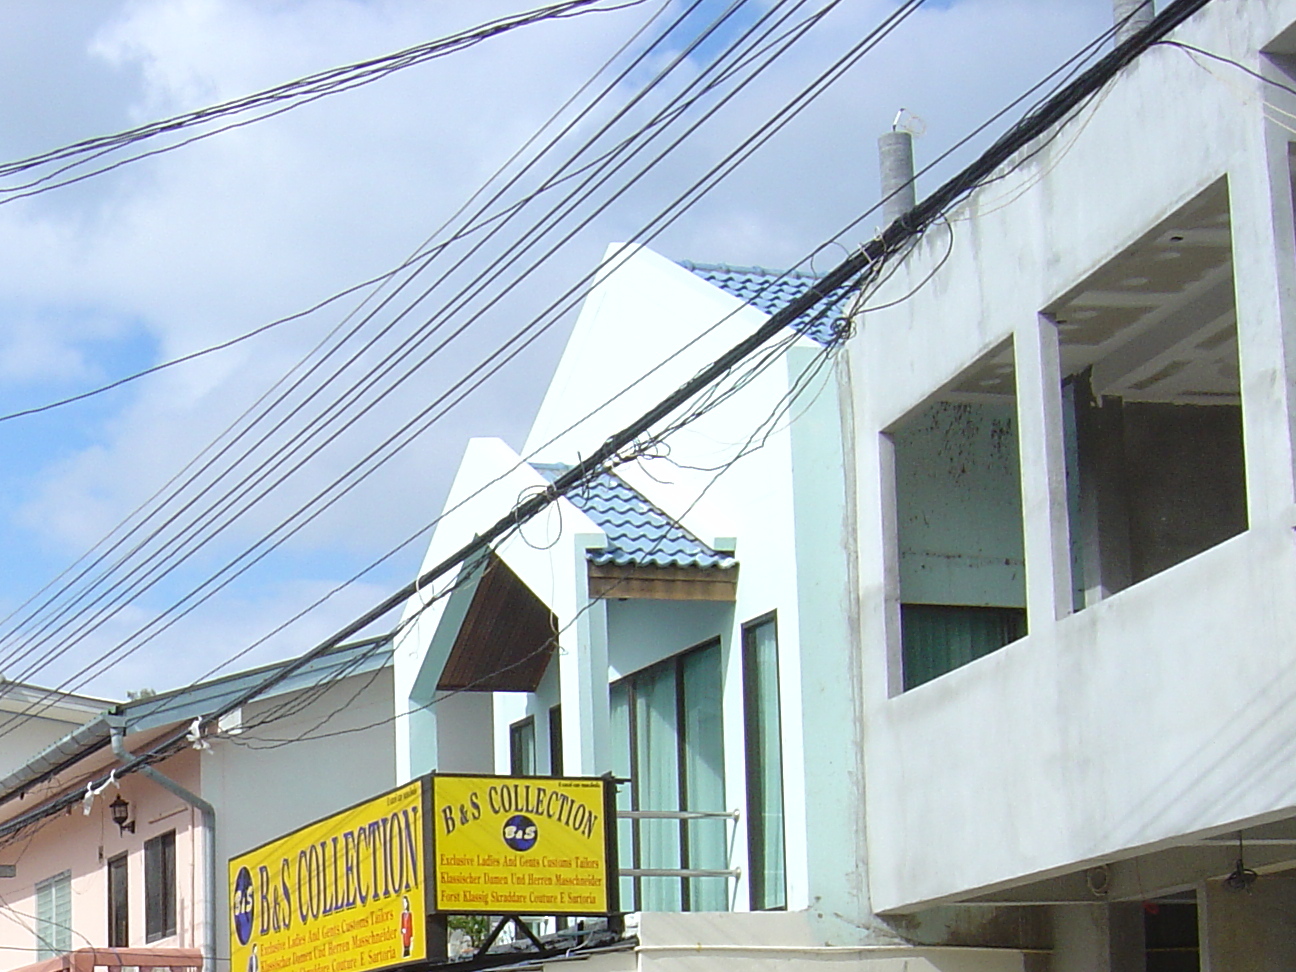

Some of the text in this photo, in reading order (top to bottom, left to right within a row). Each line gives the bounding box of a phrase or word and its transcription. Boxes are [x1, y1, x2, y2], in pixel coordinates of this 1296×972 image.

[488, 784, 598, 840] COLLECTION
[297, 806, 419, 925] COLLECTION
[440, 854, 599, 869] Exclusive Ladies And Gents Customs Tailors
[440, 872, 481, 884] Klassischer
[484, 873, 508, 885] Damen
[511, 873, 525, 886] Und
[527, 874, 552, 886] Herren
[463, 890, 488, 905] Klassig
[529, 892, 558, 904] Couture
[560, 892, 566, 904] E
[567, 891, 596, 904] Sartoria
